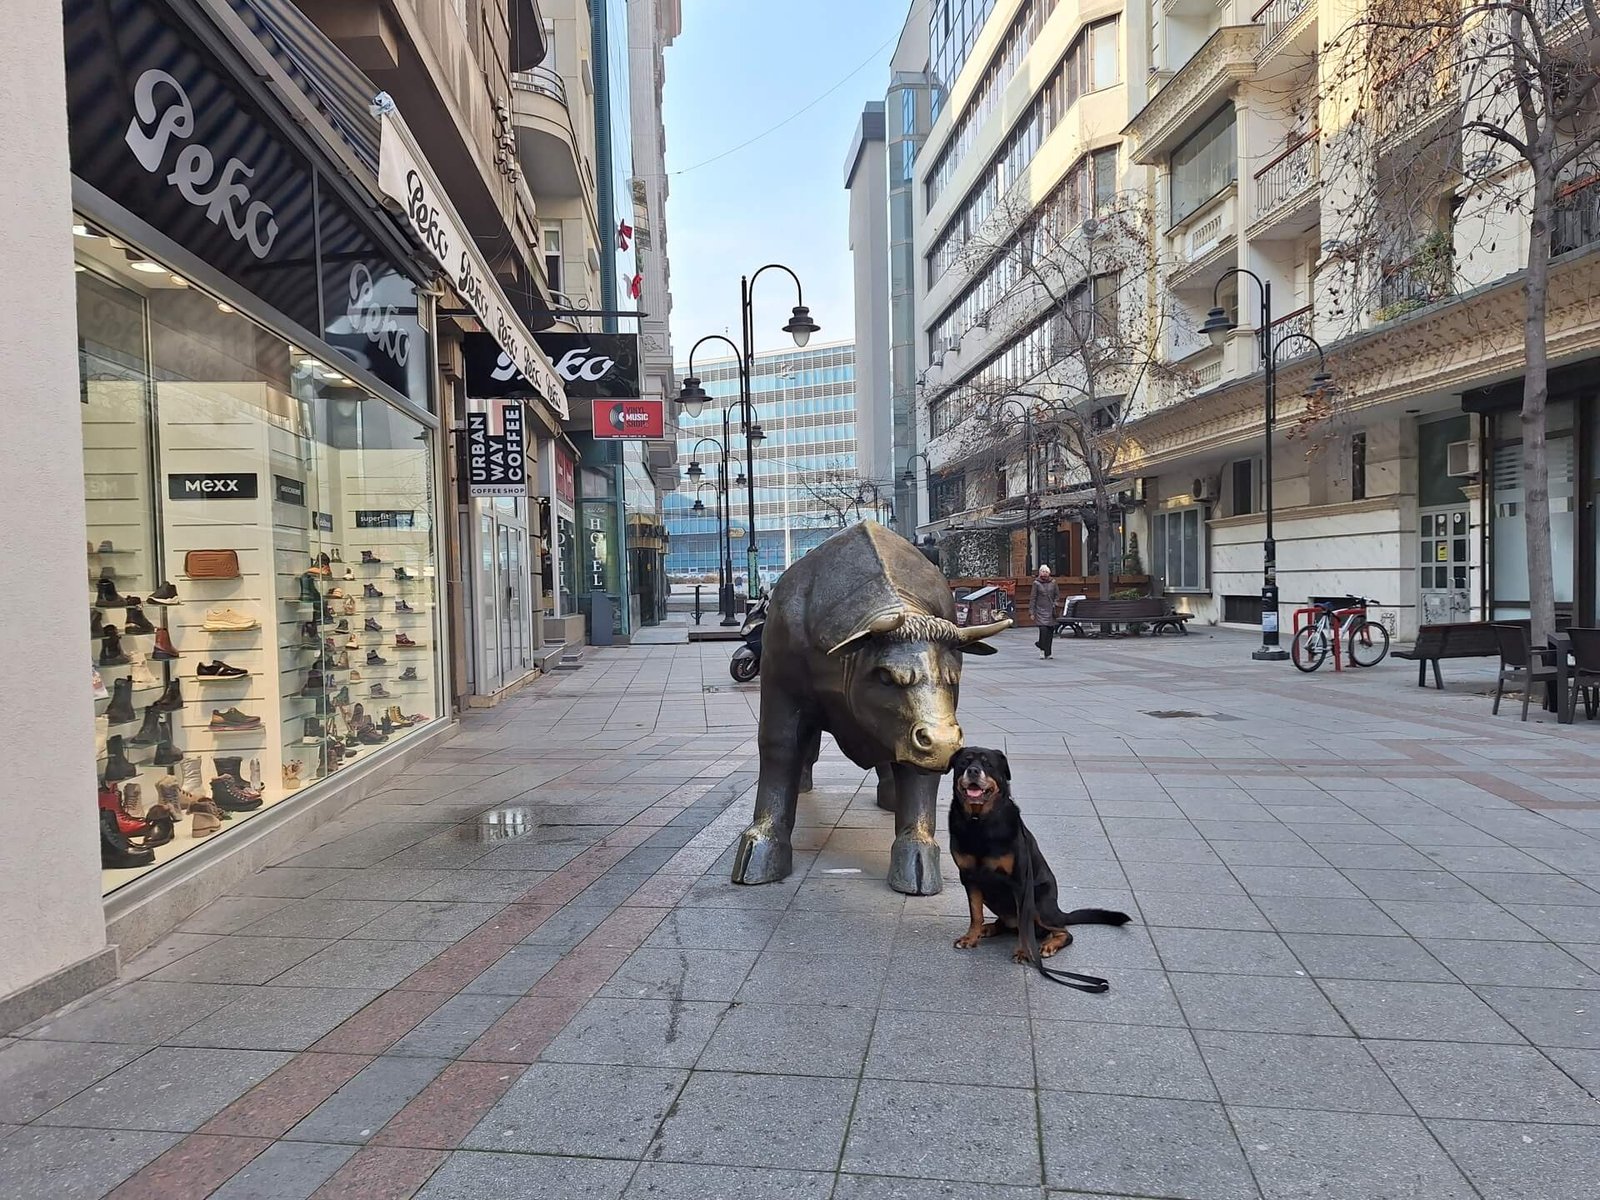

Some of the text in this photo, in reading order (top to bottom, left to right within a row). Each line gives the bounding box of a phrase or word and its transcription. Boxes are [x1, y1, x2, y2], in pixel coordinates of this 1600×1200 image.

[625, 413, 649, 421] MUSIC
[470, 417, 487, 481] URBAN
[490, 440, 504, 481] WAY
[506, 409, 522, 481] COFFEE
[360, 512, 390, 524] superfit
[590, 518, 603, 586] HOTEL
